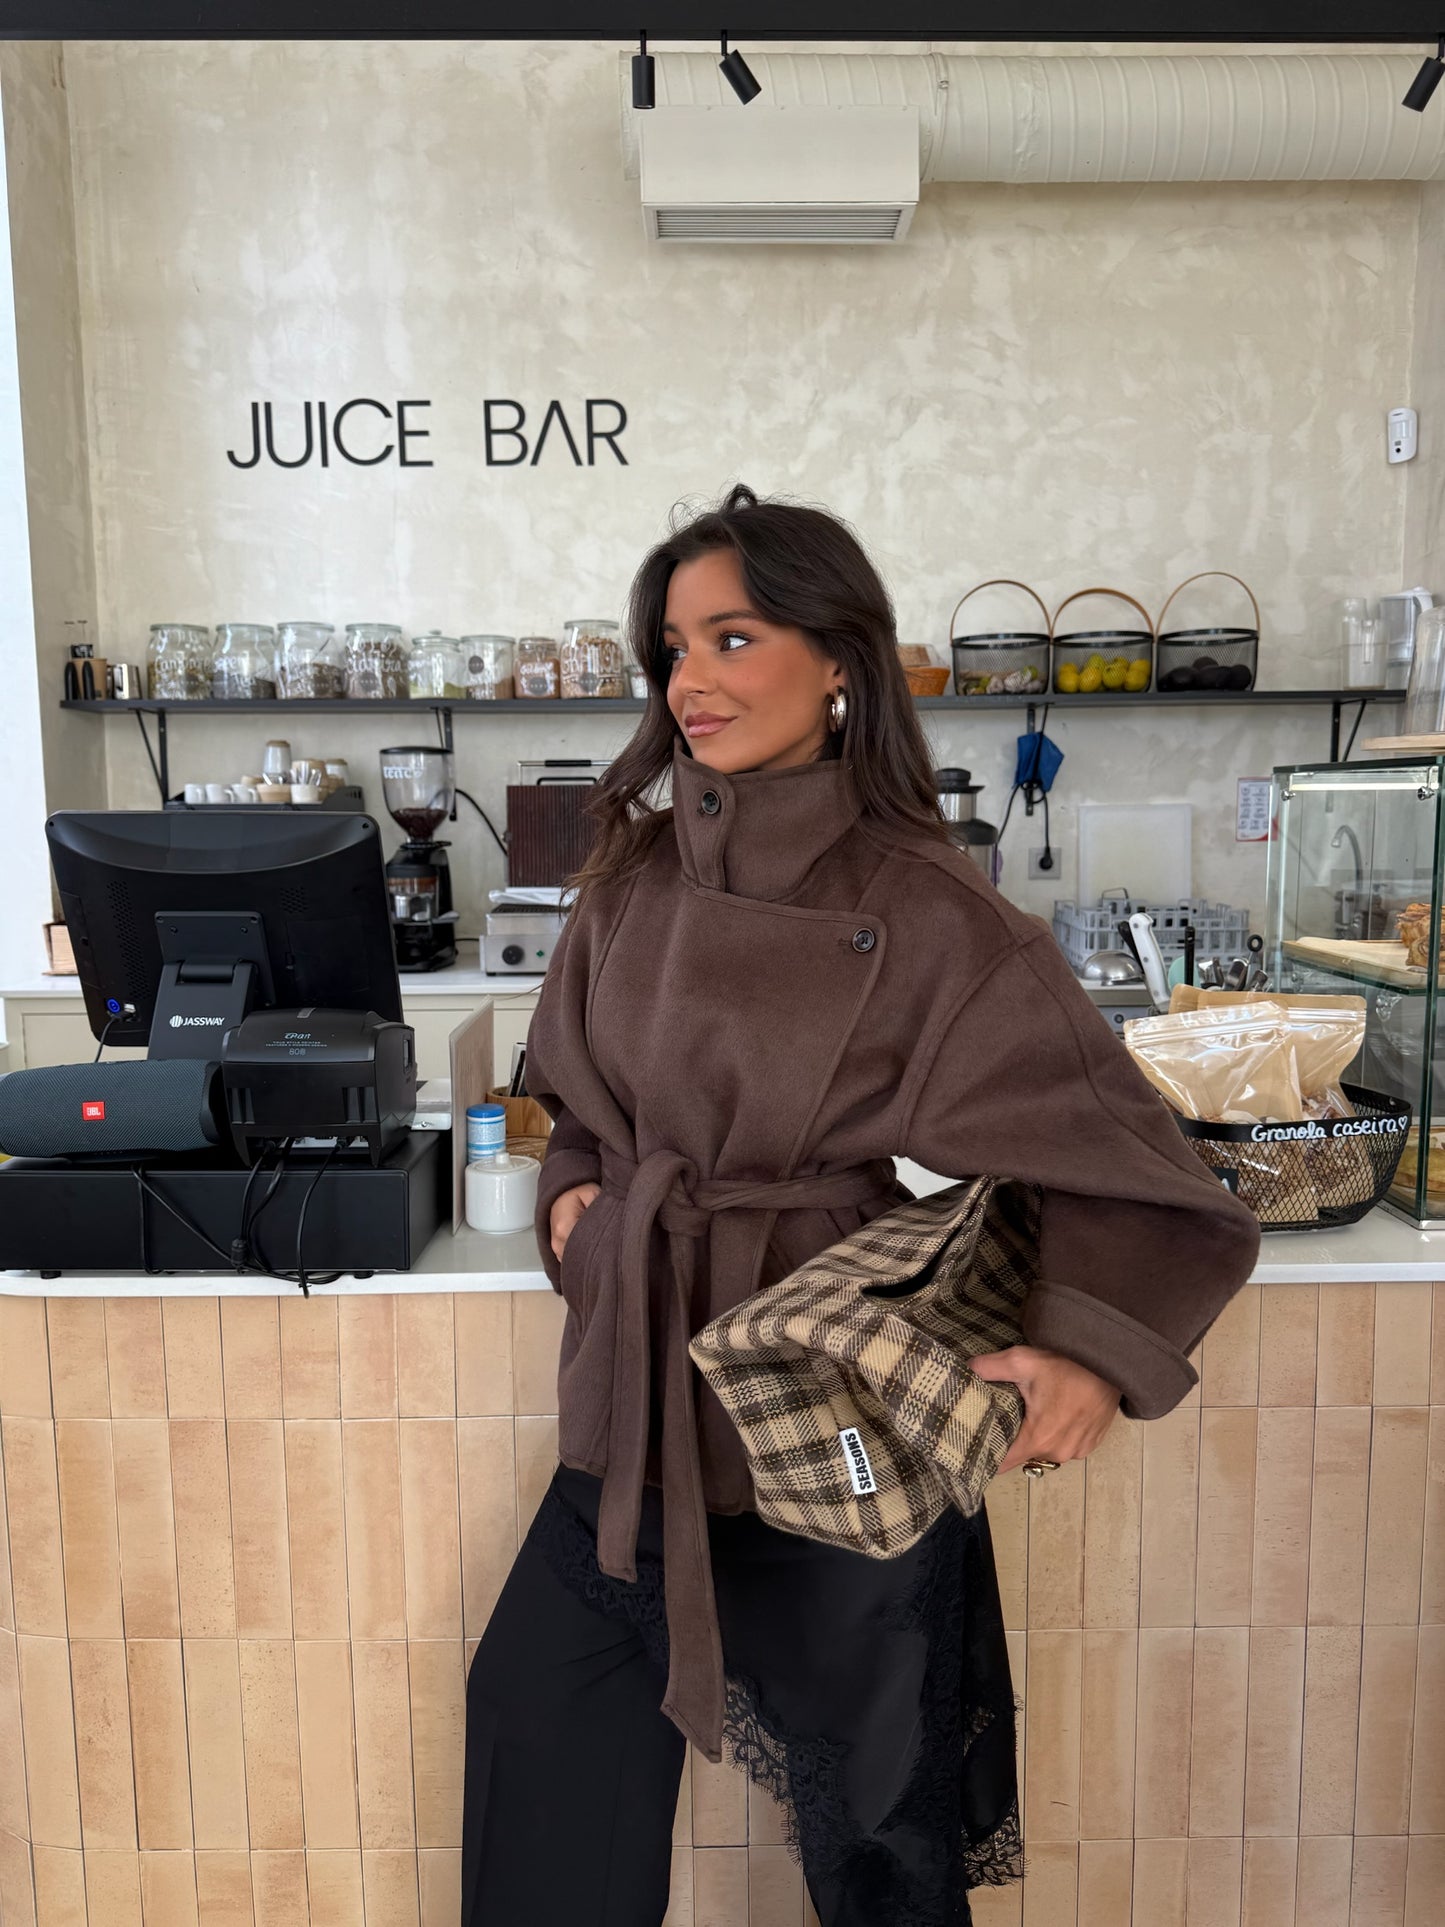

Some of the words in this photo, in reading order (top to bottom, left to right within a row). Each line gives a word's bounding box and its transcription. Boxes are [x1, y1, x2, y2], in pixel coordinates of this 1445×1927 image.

[226, 398, 434, 470] JUICE
[483, 399, 630, 467] BAR
[183, 1016, 225, 1026] JASSWAY
[86, 1106, 102, 1117] JBL
[1250, 1121, 1327, 1143] Granola
[1332, 1117, 1400, 1138] caseira
[845, 1432, 872, 1490] SEASONS
